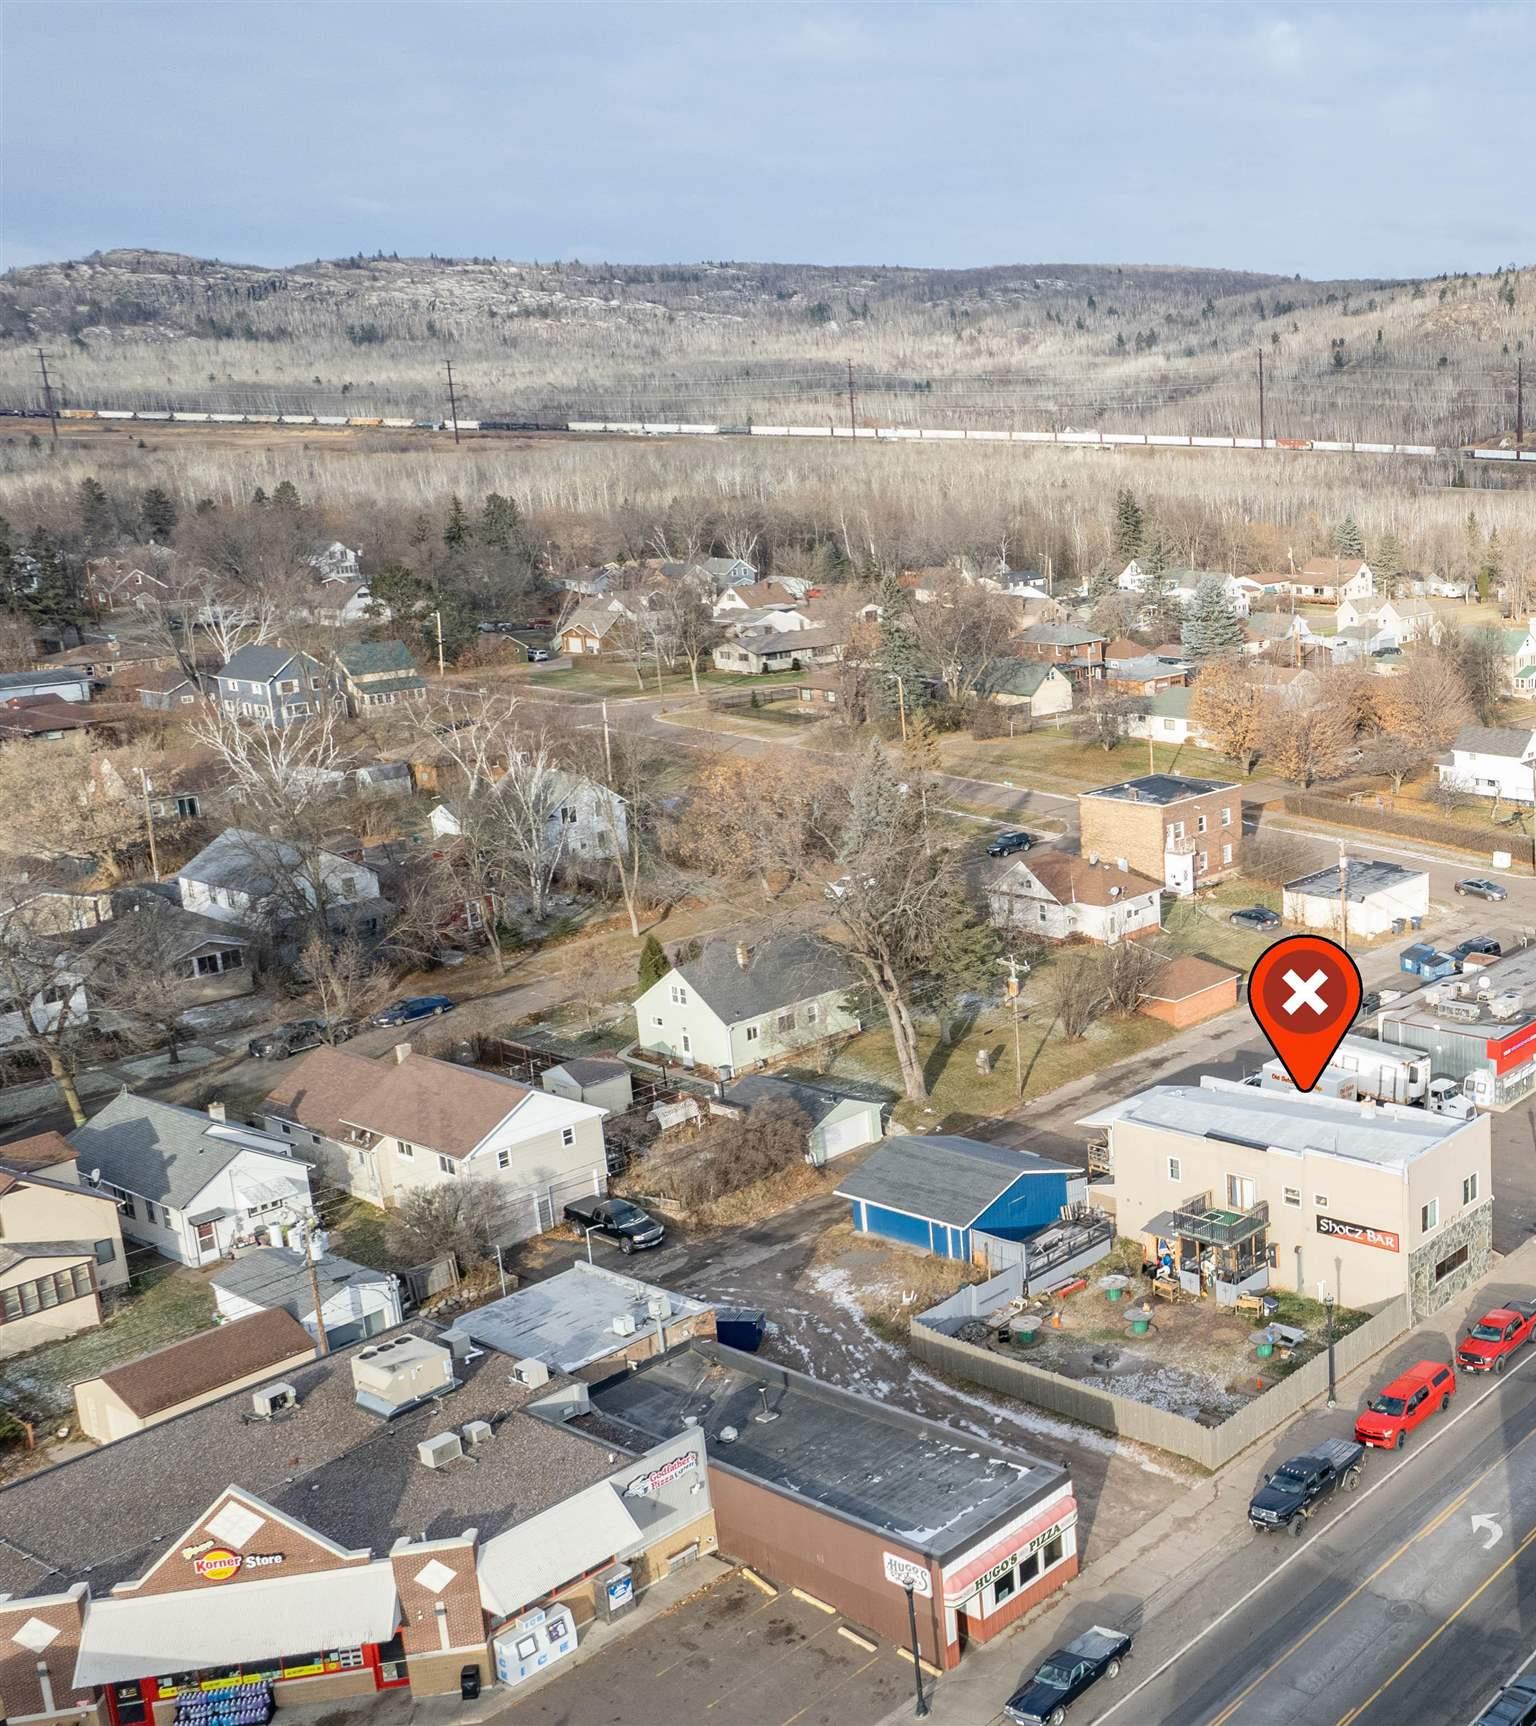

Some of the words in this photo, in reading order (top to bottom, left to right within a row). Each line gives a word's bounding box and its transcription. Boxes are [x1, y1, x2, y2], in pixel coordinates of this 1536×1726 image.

[195, 1557, 241, 1573] Korner
[245, 1555, 282, 1569] Store
[975, 1553, 1018, 1591] HUGO'S
[1029, 1524, 1061, 1552] PIZZA
